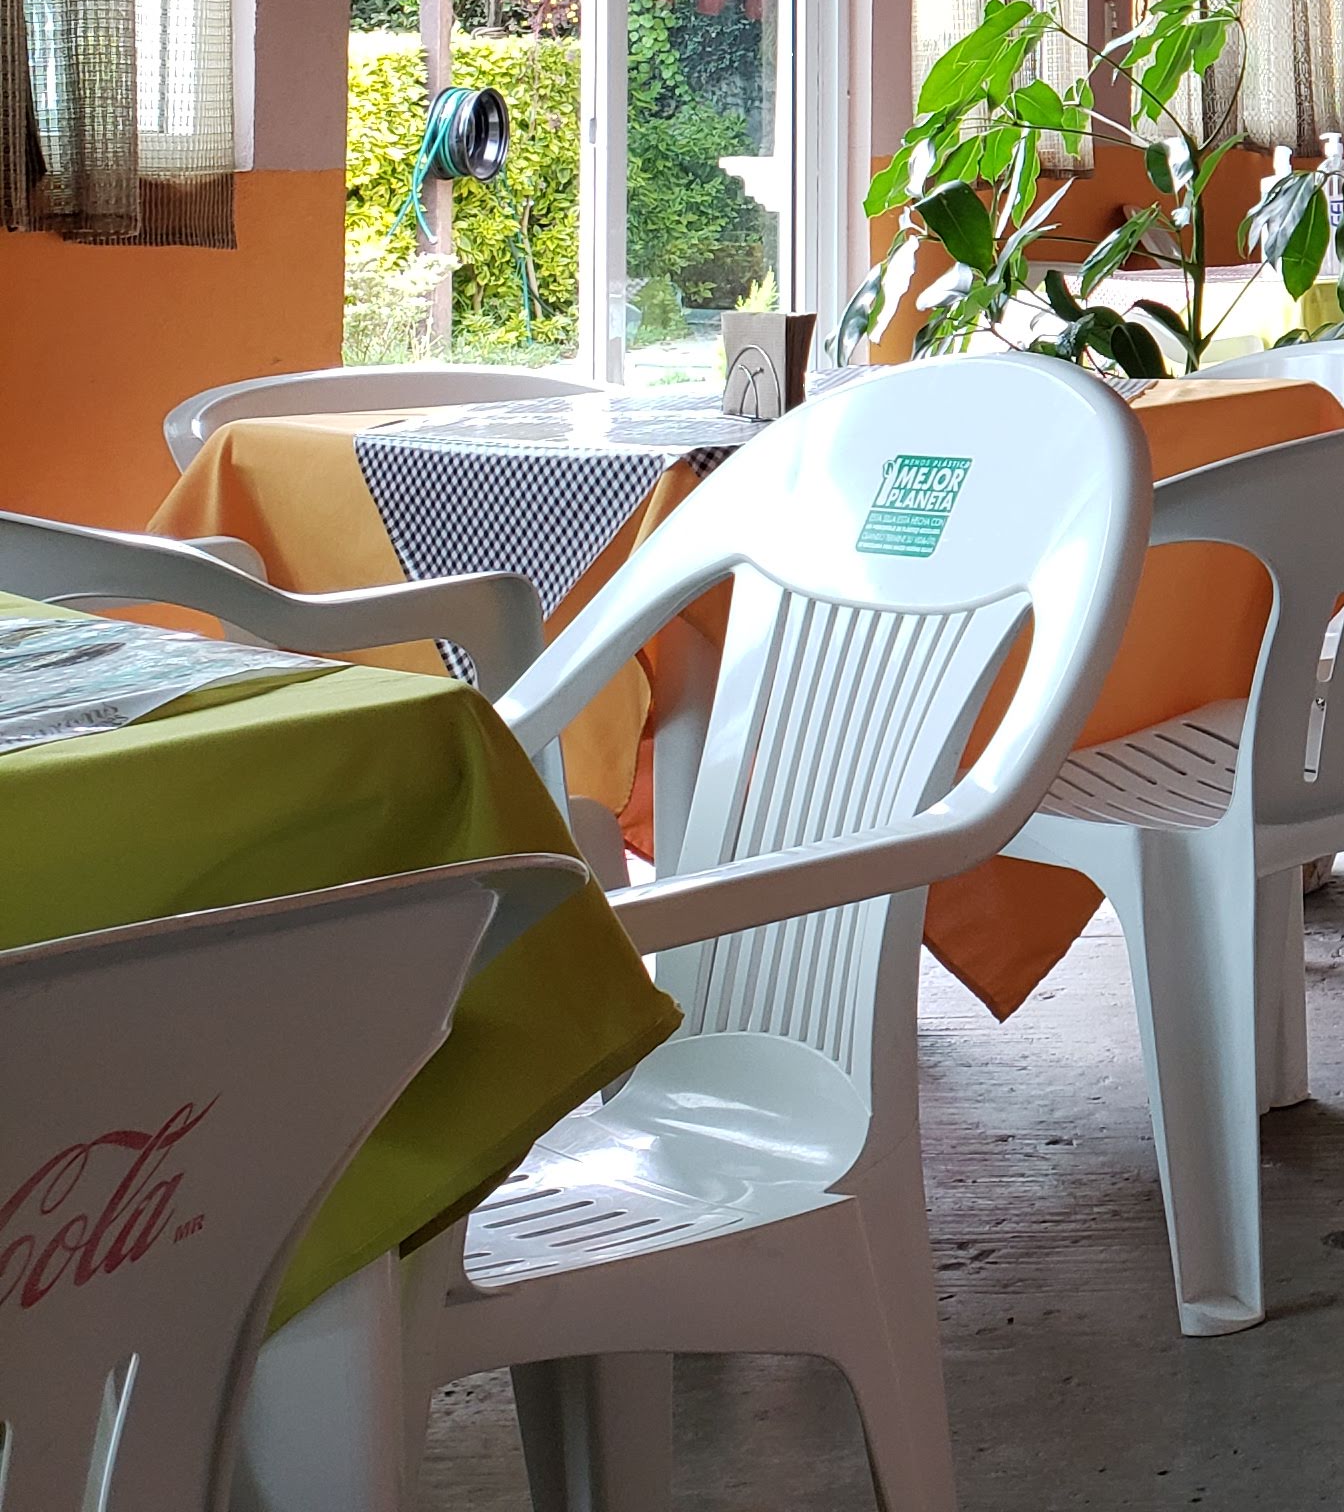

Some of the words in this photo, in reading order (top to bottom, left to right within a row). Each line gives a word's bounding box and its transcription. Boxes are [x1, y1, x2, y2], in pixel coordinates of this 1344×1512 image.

[893, 465, 965, 492] MEJOR
[884, 489, 954, 511] PLANETA
[172, 1213, 205, 1244] MR
